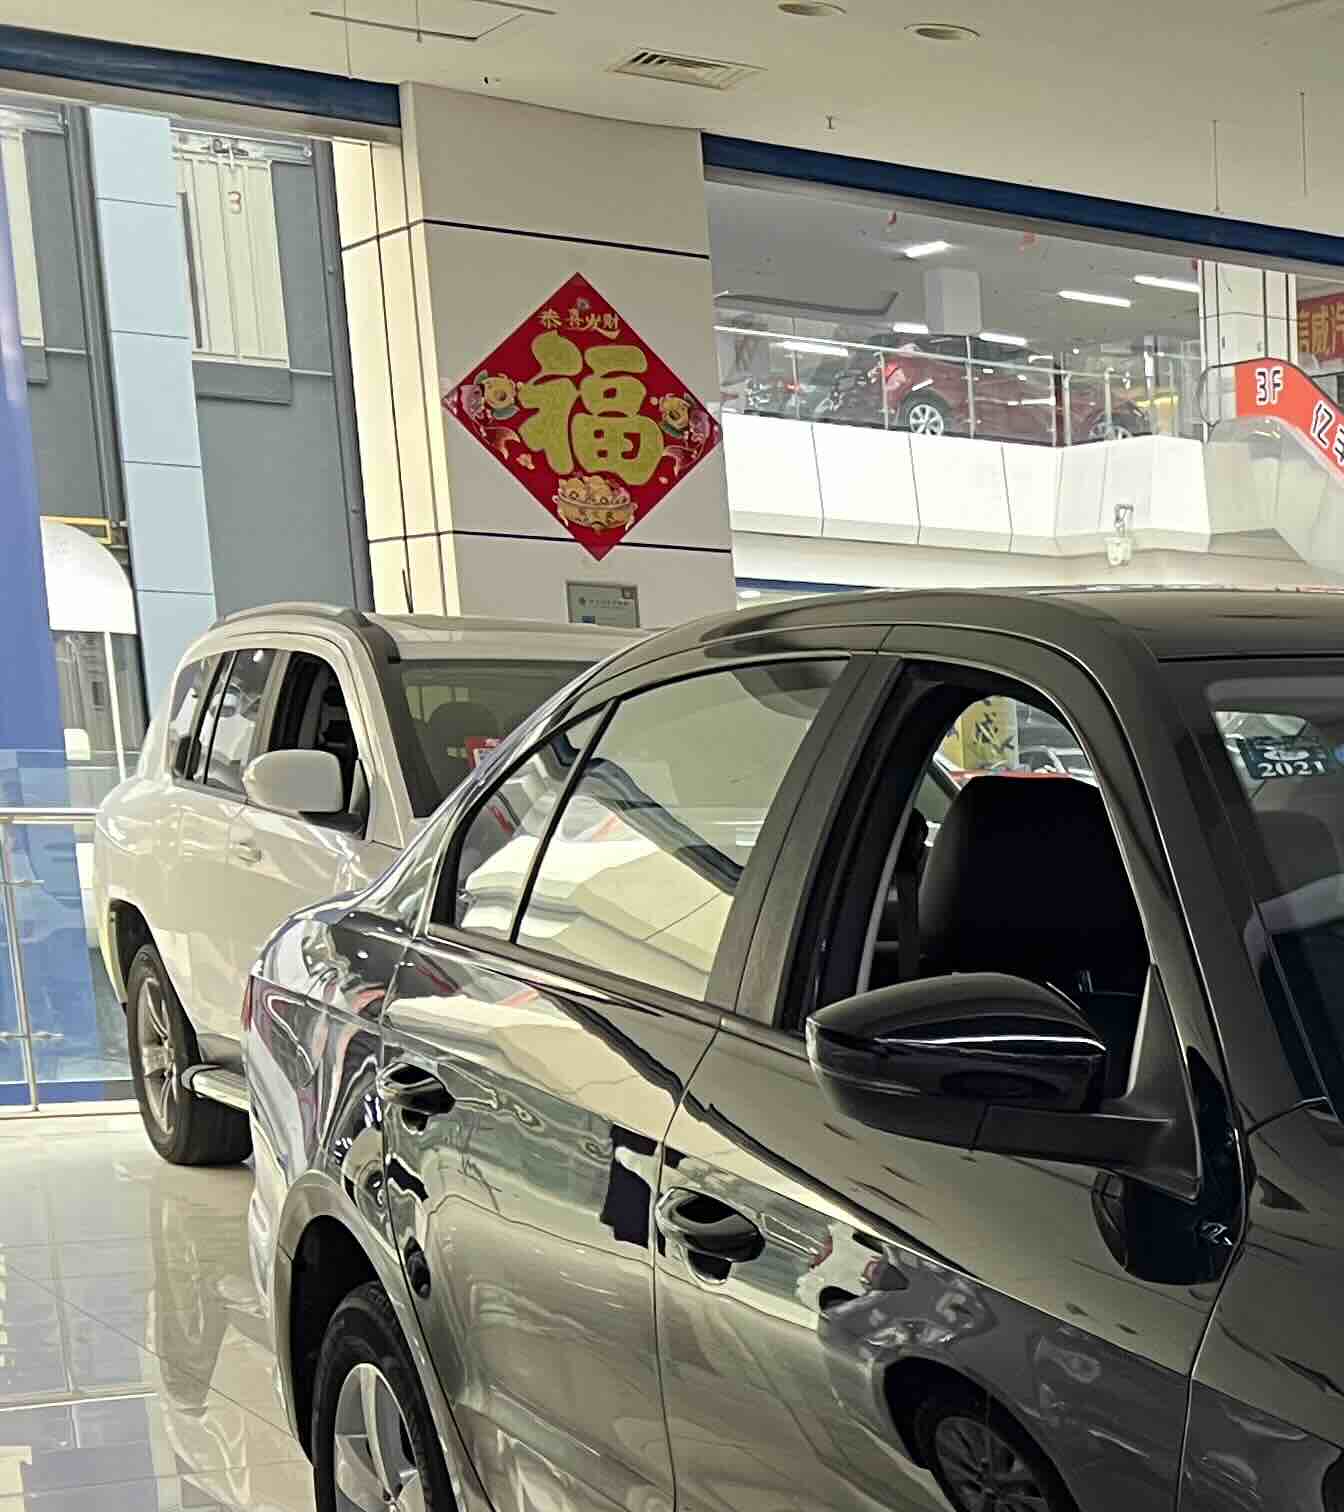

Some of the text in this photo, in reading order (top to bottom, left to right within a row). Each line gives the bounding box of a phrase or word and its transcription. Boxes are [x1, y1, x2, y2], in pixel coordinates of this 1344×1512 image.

[1255, 366, 1284, 405] 3F
[516, 329, 665, 486] 福
[1257, 760, 1327, 777] 2021
